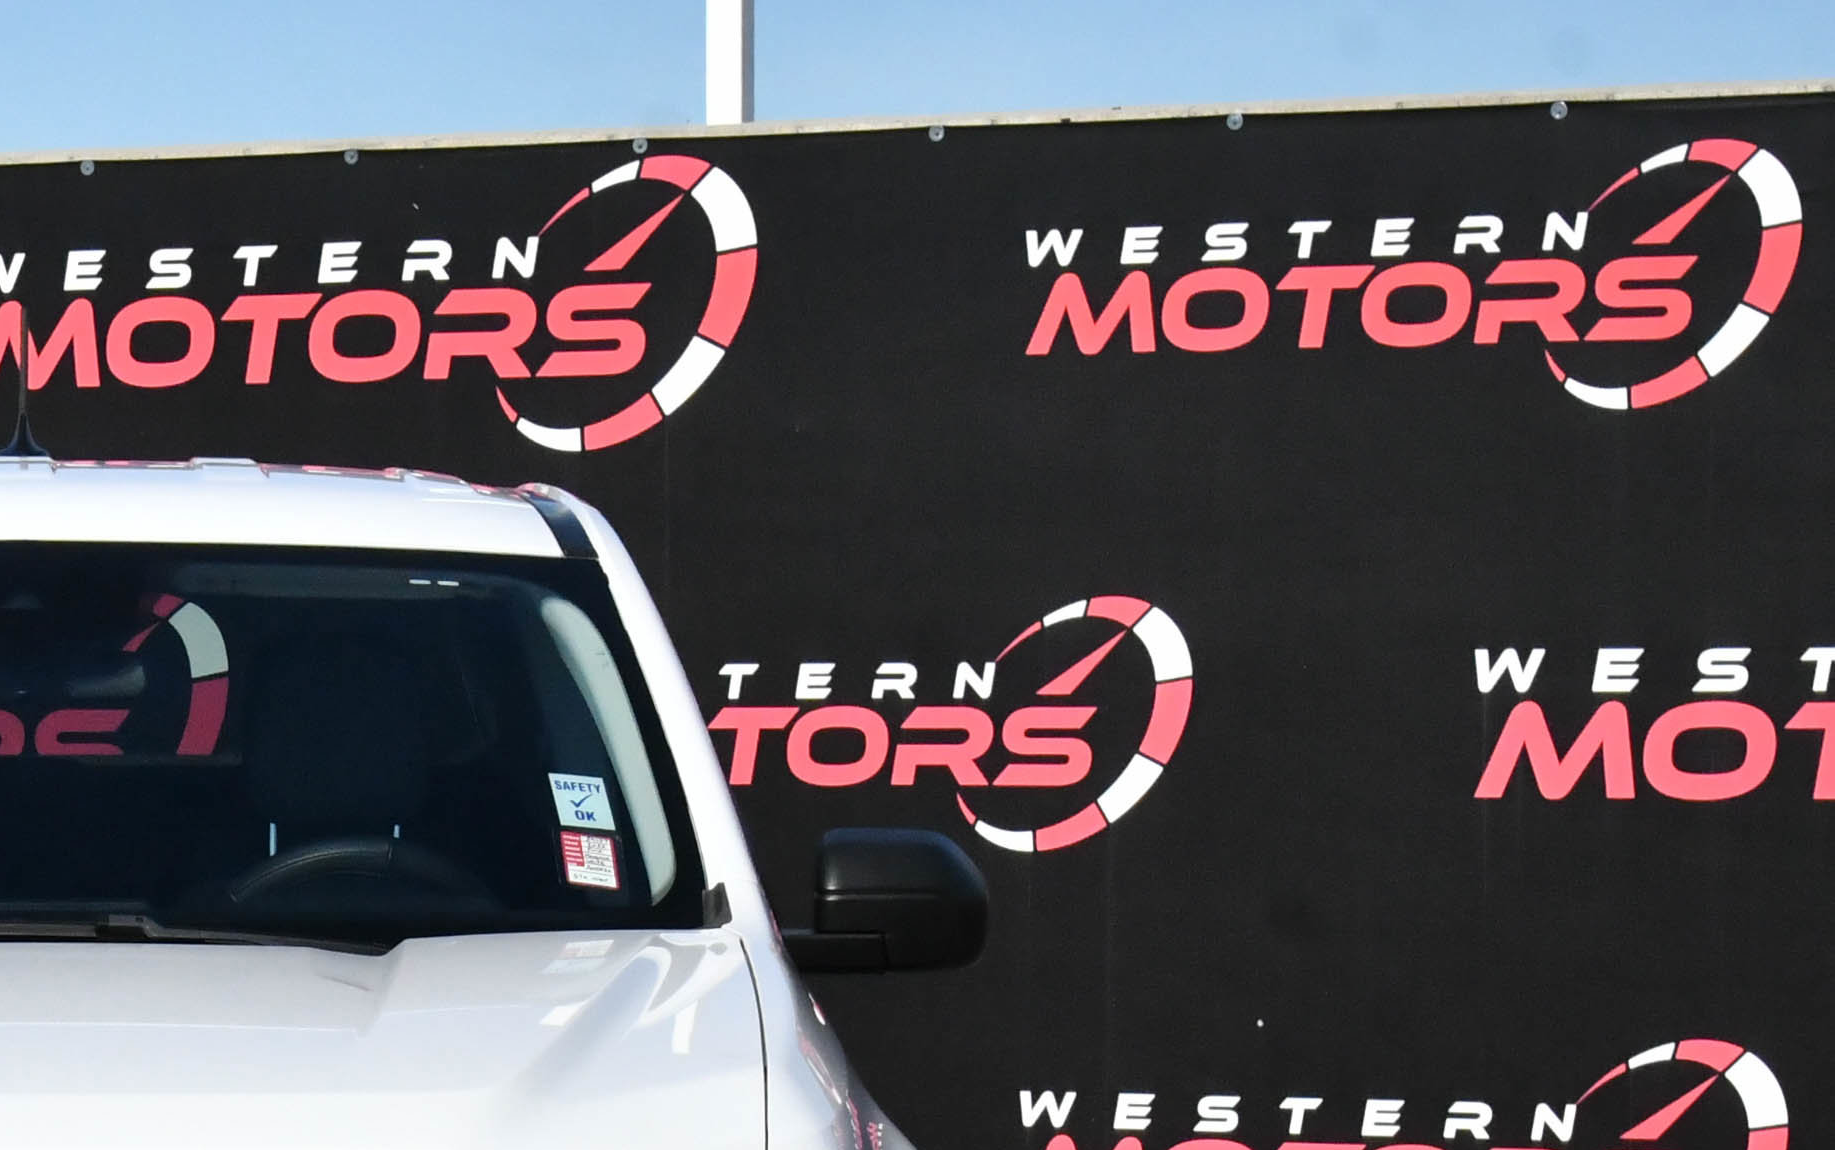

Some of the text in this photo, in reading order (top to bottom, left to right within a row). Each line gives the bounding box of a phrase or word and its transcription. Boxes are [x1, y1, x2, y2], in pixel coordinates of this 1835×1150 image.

[1026, 212, 1589, 267] WESTERN
[1025, 255, 1699, 355] MOTORS
[554, 780, 602, 794] SAFETY
[574, 809, 597, 822] OK
[1019, 1091, 1576, 1142] WESTERN
